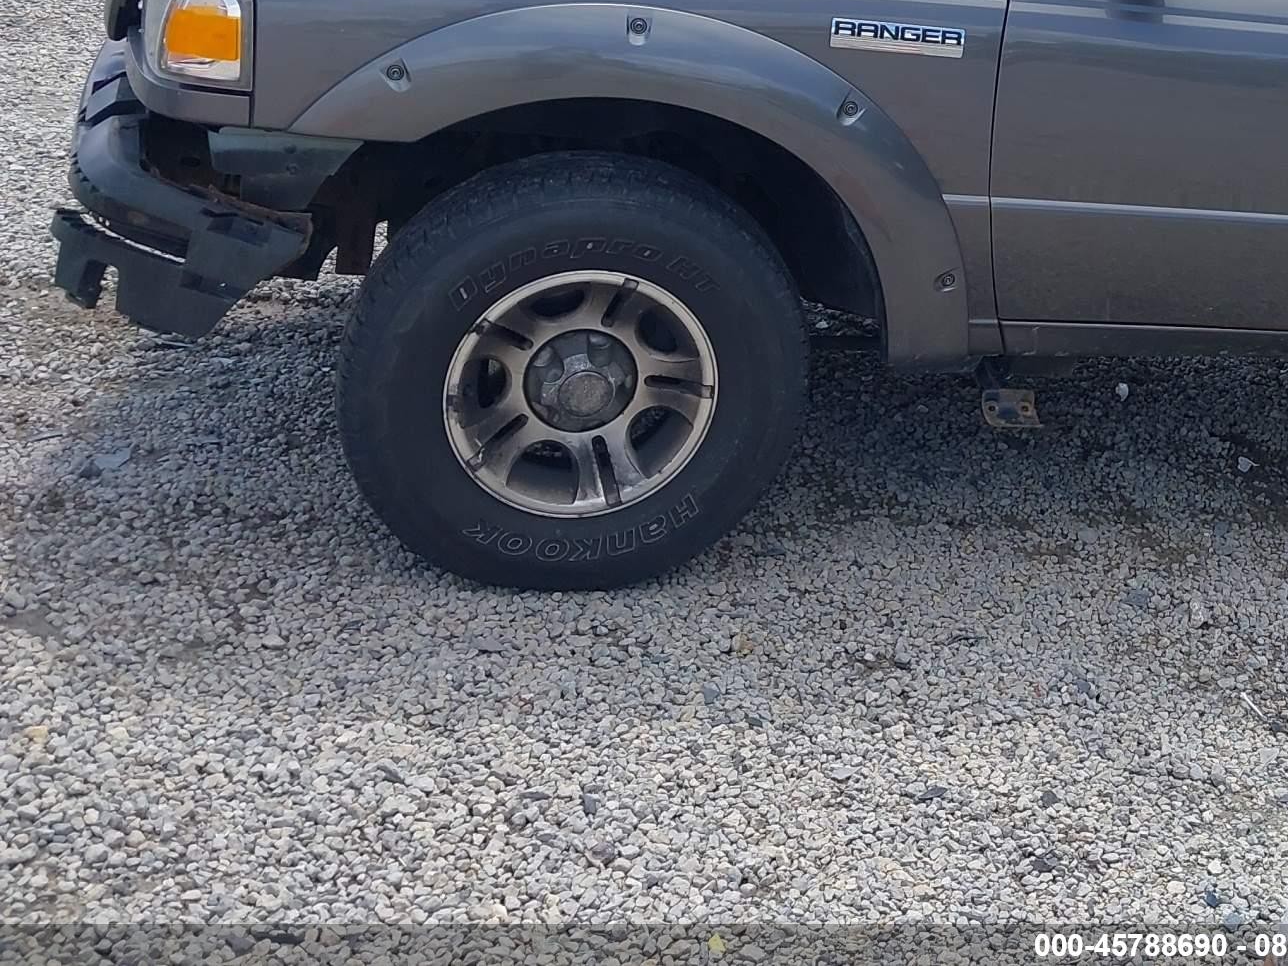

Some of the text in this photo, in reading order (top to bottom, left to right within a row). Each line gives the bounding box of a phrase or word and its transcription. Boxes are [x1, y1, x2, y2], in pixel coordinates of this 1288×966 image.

[833, 20, 964, 46] RANGER
[449, 237, 722, 312] Dynapro HT
[461, 491, 702, 562] Hankook
